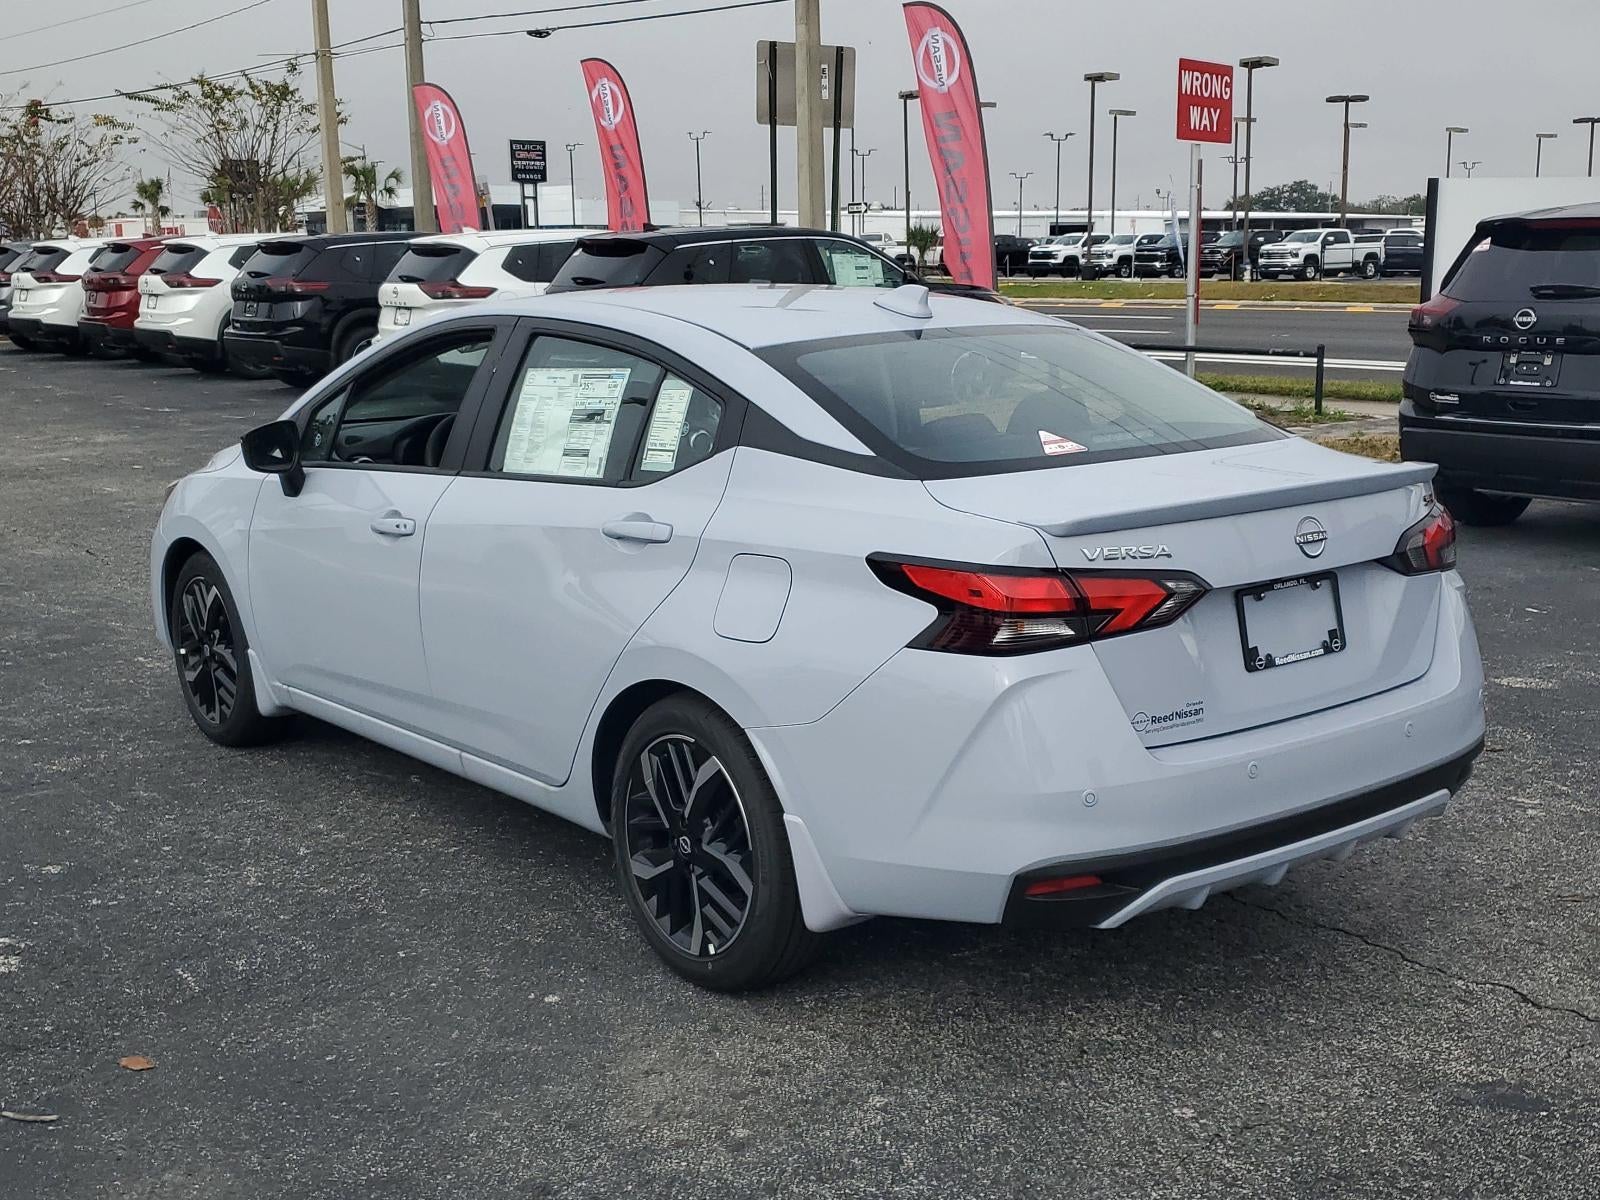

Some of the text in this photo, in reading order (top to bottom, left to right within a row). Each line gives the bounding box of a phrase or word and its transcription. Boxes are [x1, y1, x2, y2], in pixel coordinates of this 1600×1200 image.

[1181, 69, 1231, 100] WRONG
[1189, 105, 1221, 132] WAY
[516, 151, 542, 159] GMC
[1482, 335, 1566, 345] ROGUE
[1296, 531, 1327, 543] NISSAN
[1080, 544, 1172, 562] VERSA
[1275, 648, 1324, 665] ReedNissan.com
